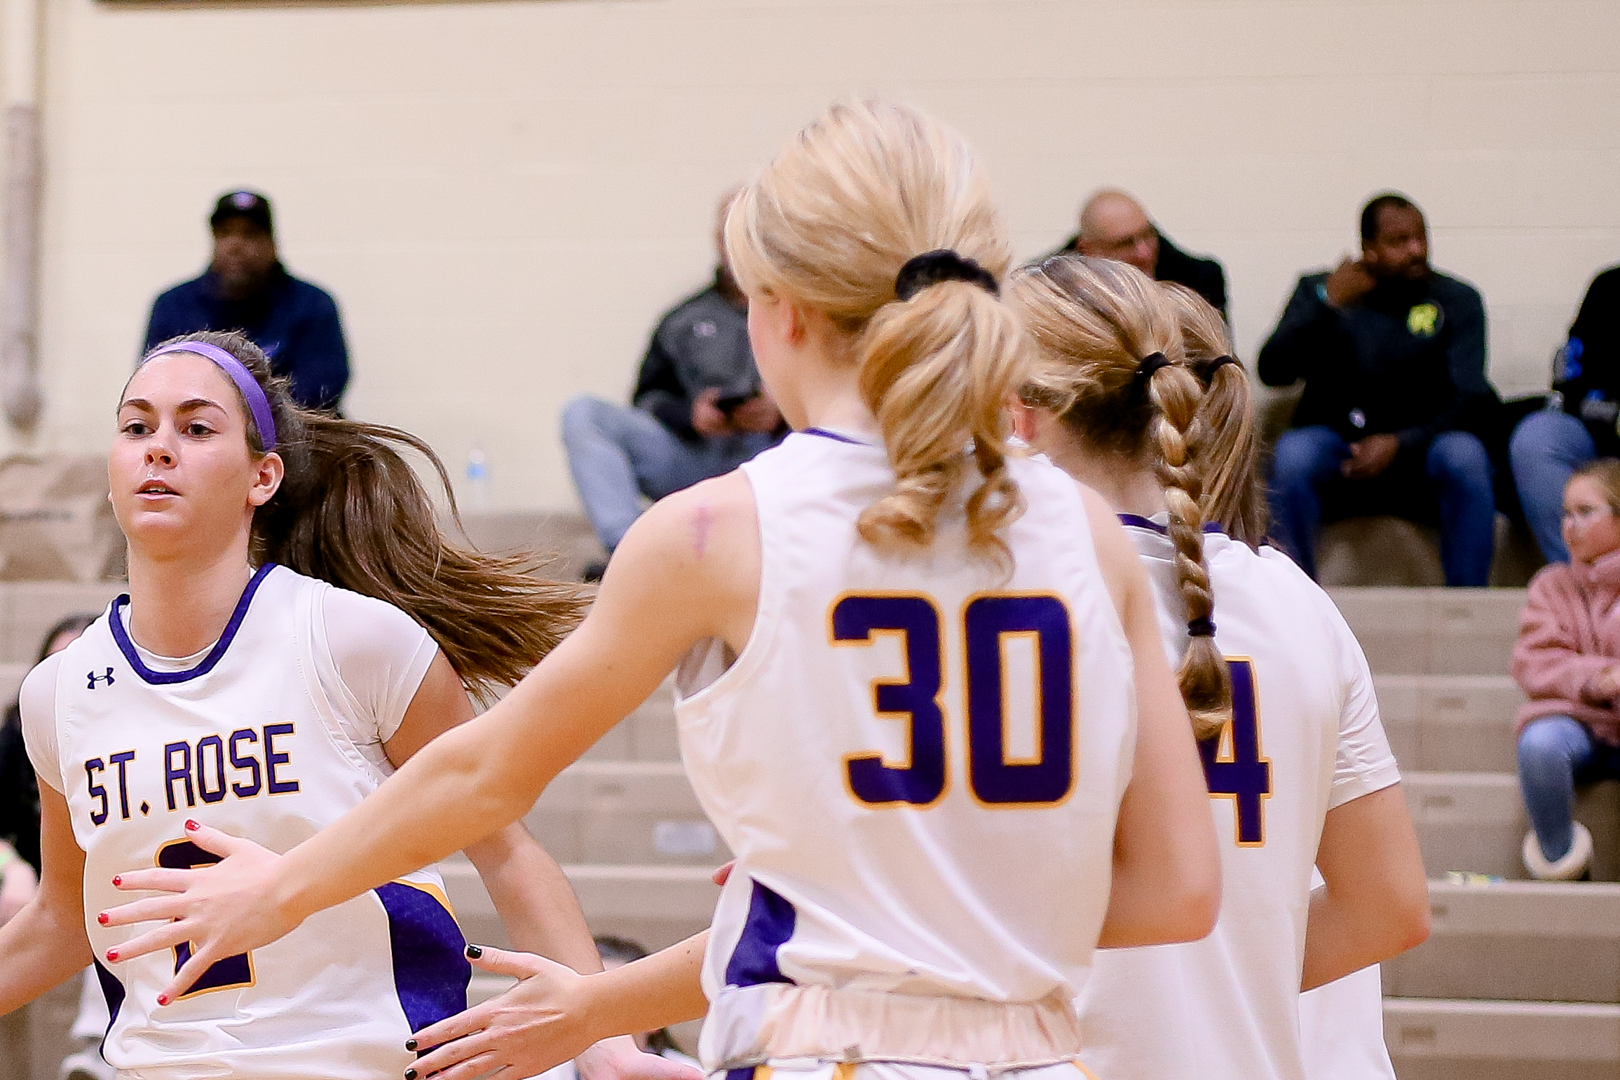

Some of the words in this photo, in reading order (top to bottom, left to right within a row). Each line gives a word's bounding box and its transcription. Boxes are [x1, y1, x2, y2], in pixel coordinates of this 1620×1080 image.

[84, 749, 151, 827] ST.
[164, 722, 301, 811] ROSE
[827, 590, 1077, 810] 30
